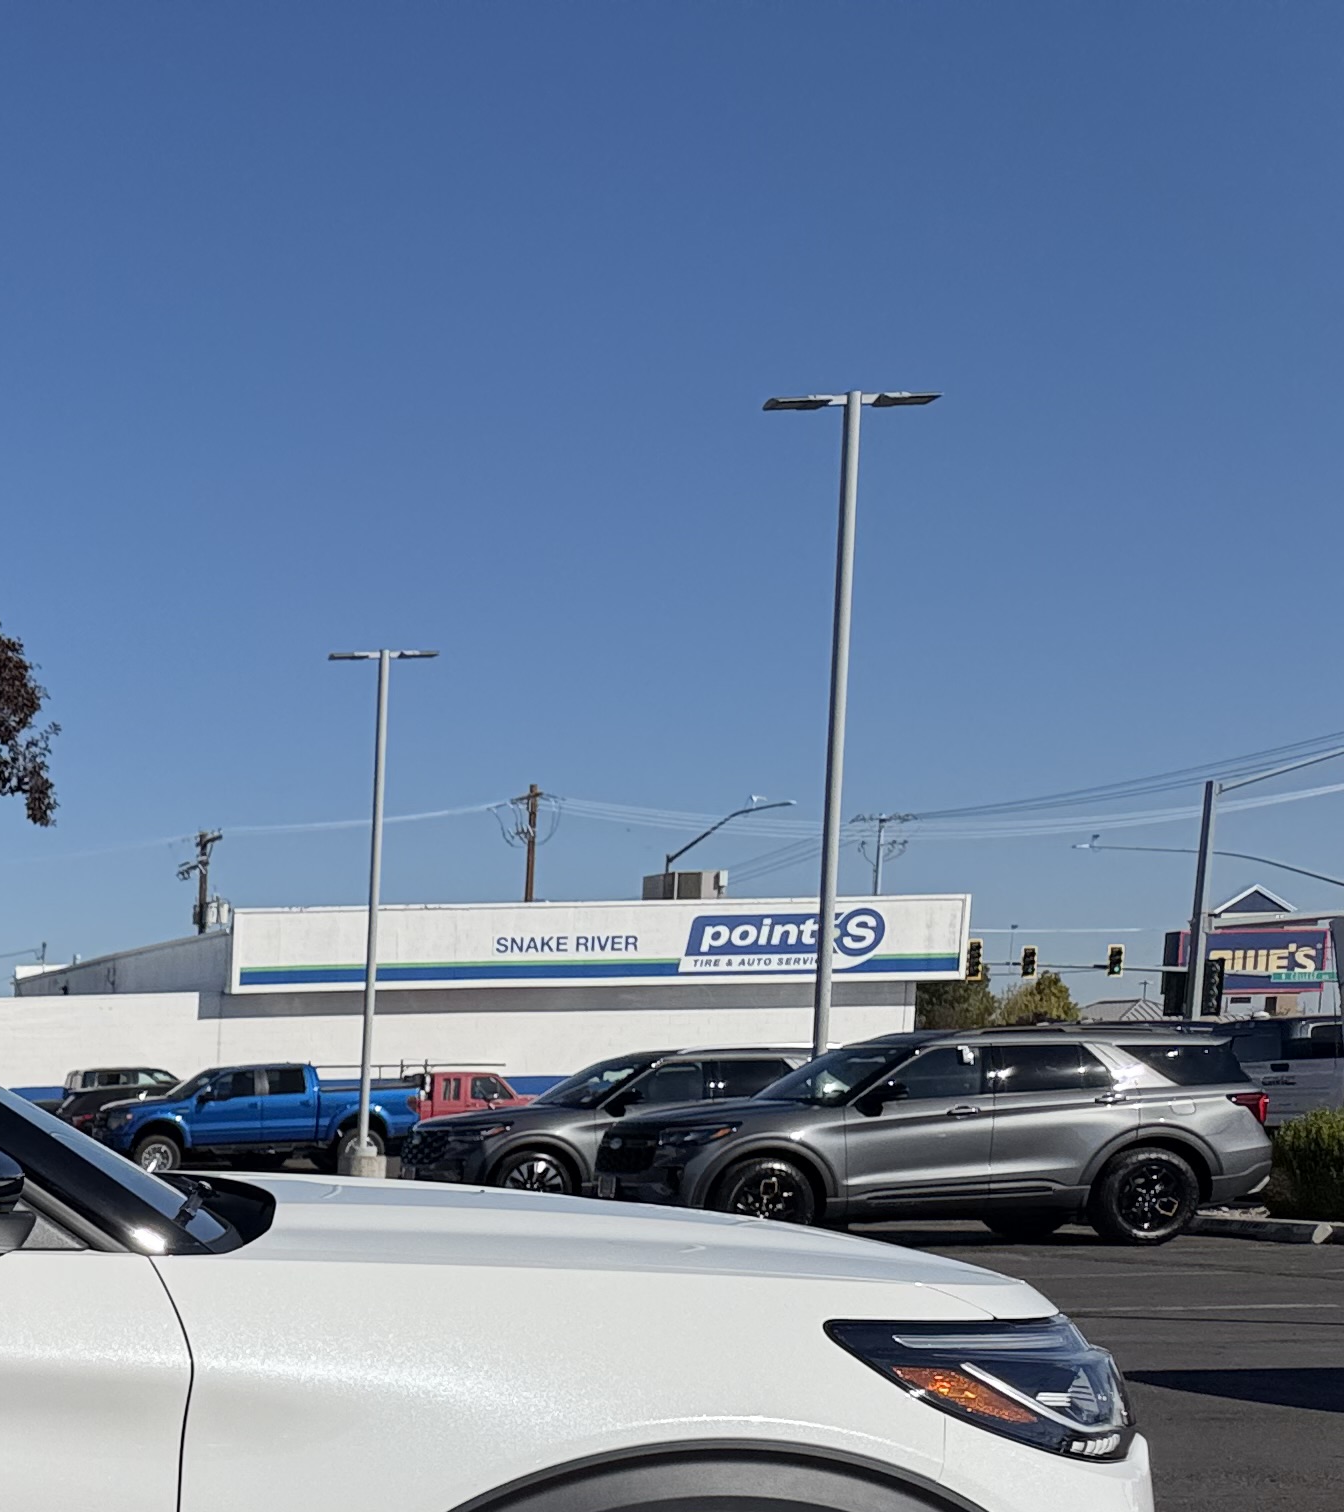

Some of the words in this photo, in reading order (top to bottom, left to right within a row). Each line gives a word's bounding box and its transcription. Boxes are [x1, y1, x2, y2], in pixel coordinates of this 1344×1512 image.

[700, 917, 818, 953] point
[842, 914, 877, 950] S
[495, 935, 569, 954] SNAKE
[575, 934, 639, 953] RIVER
[692, 958, 721, 968] TIRE
[725, 957, 734, 968] &
[737, 957, 772, 968] AUTO
